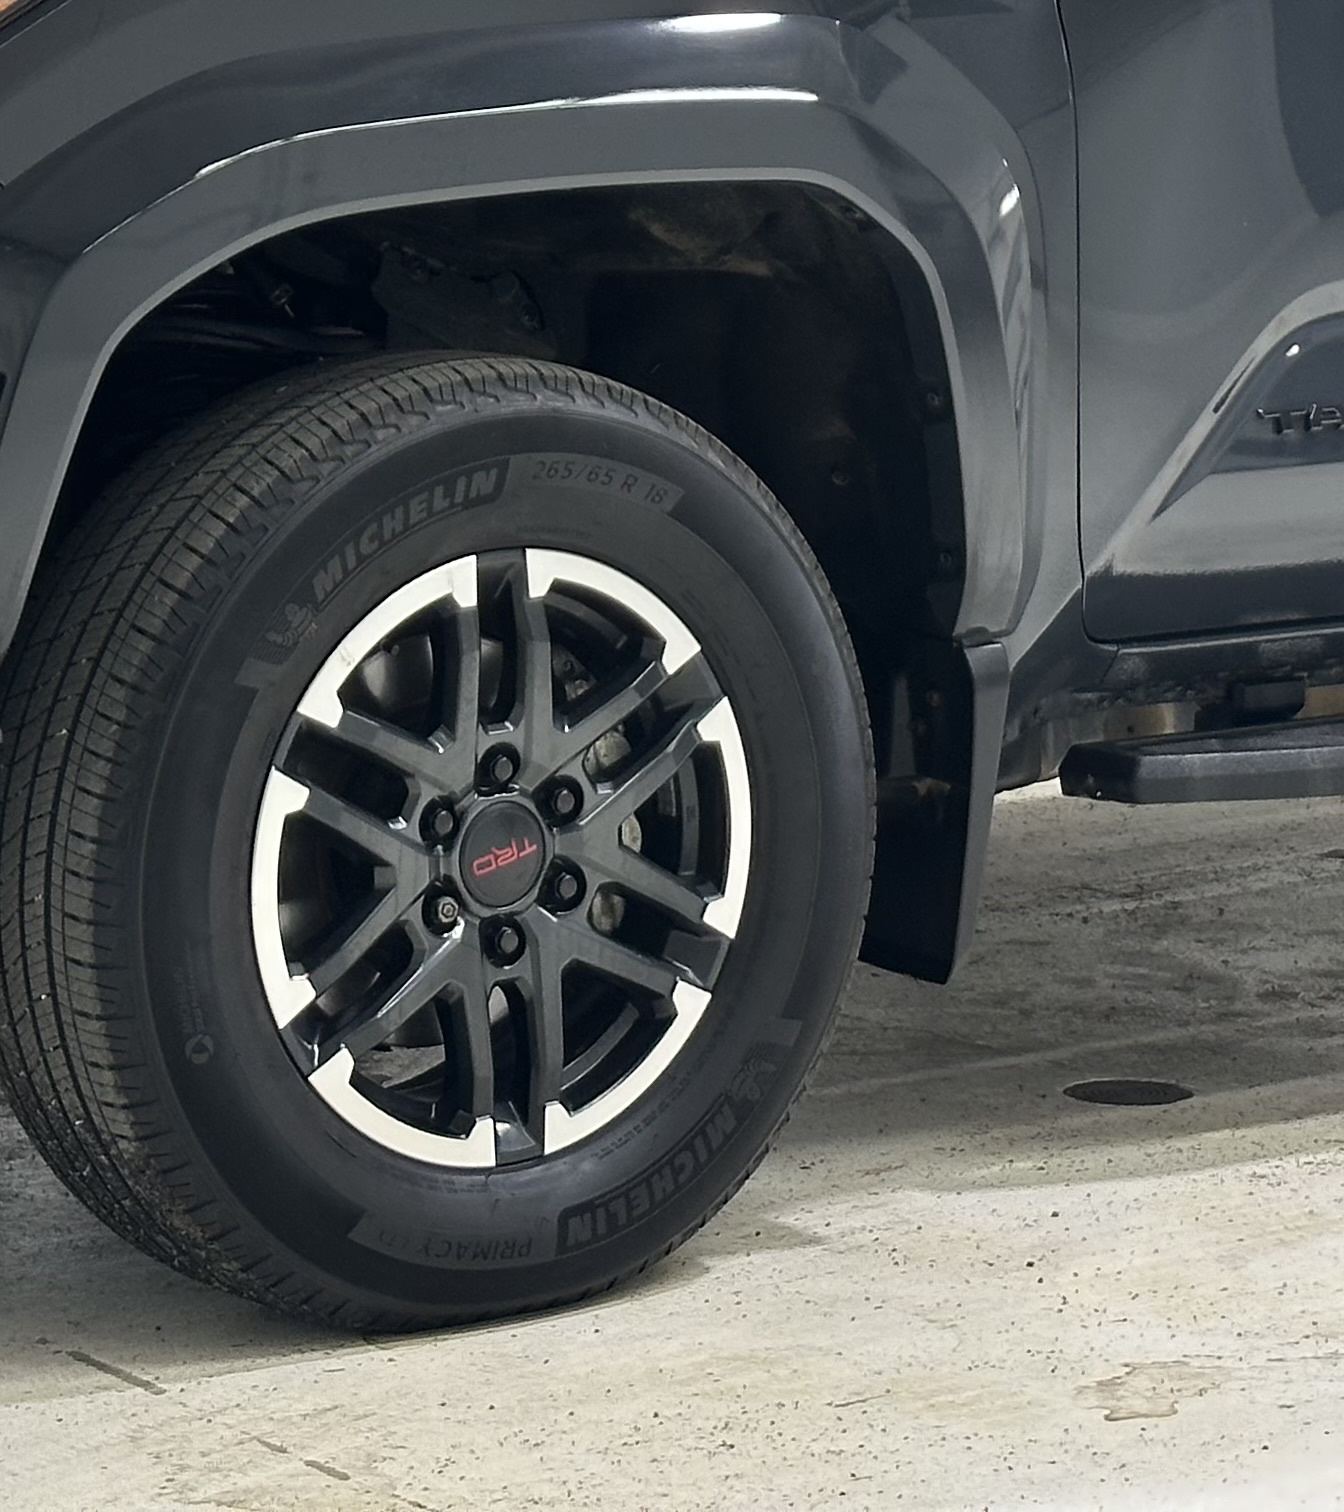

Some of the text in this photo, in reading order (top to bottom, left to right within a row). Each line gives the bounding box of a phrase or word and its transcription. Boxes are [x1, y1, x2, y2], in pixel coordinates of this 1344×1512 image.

[531, 460, 617, 487] 265/65
[620, 472, 640, 494] R
[312, 467, 499, 603] MICHELIN
[471, 836, 539, 878] TRD
[564, 1100, 739, 1250] MICHELIN
[415, 1235, 534, 1262] PRIMACY
